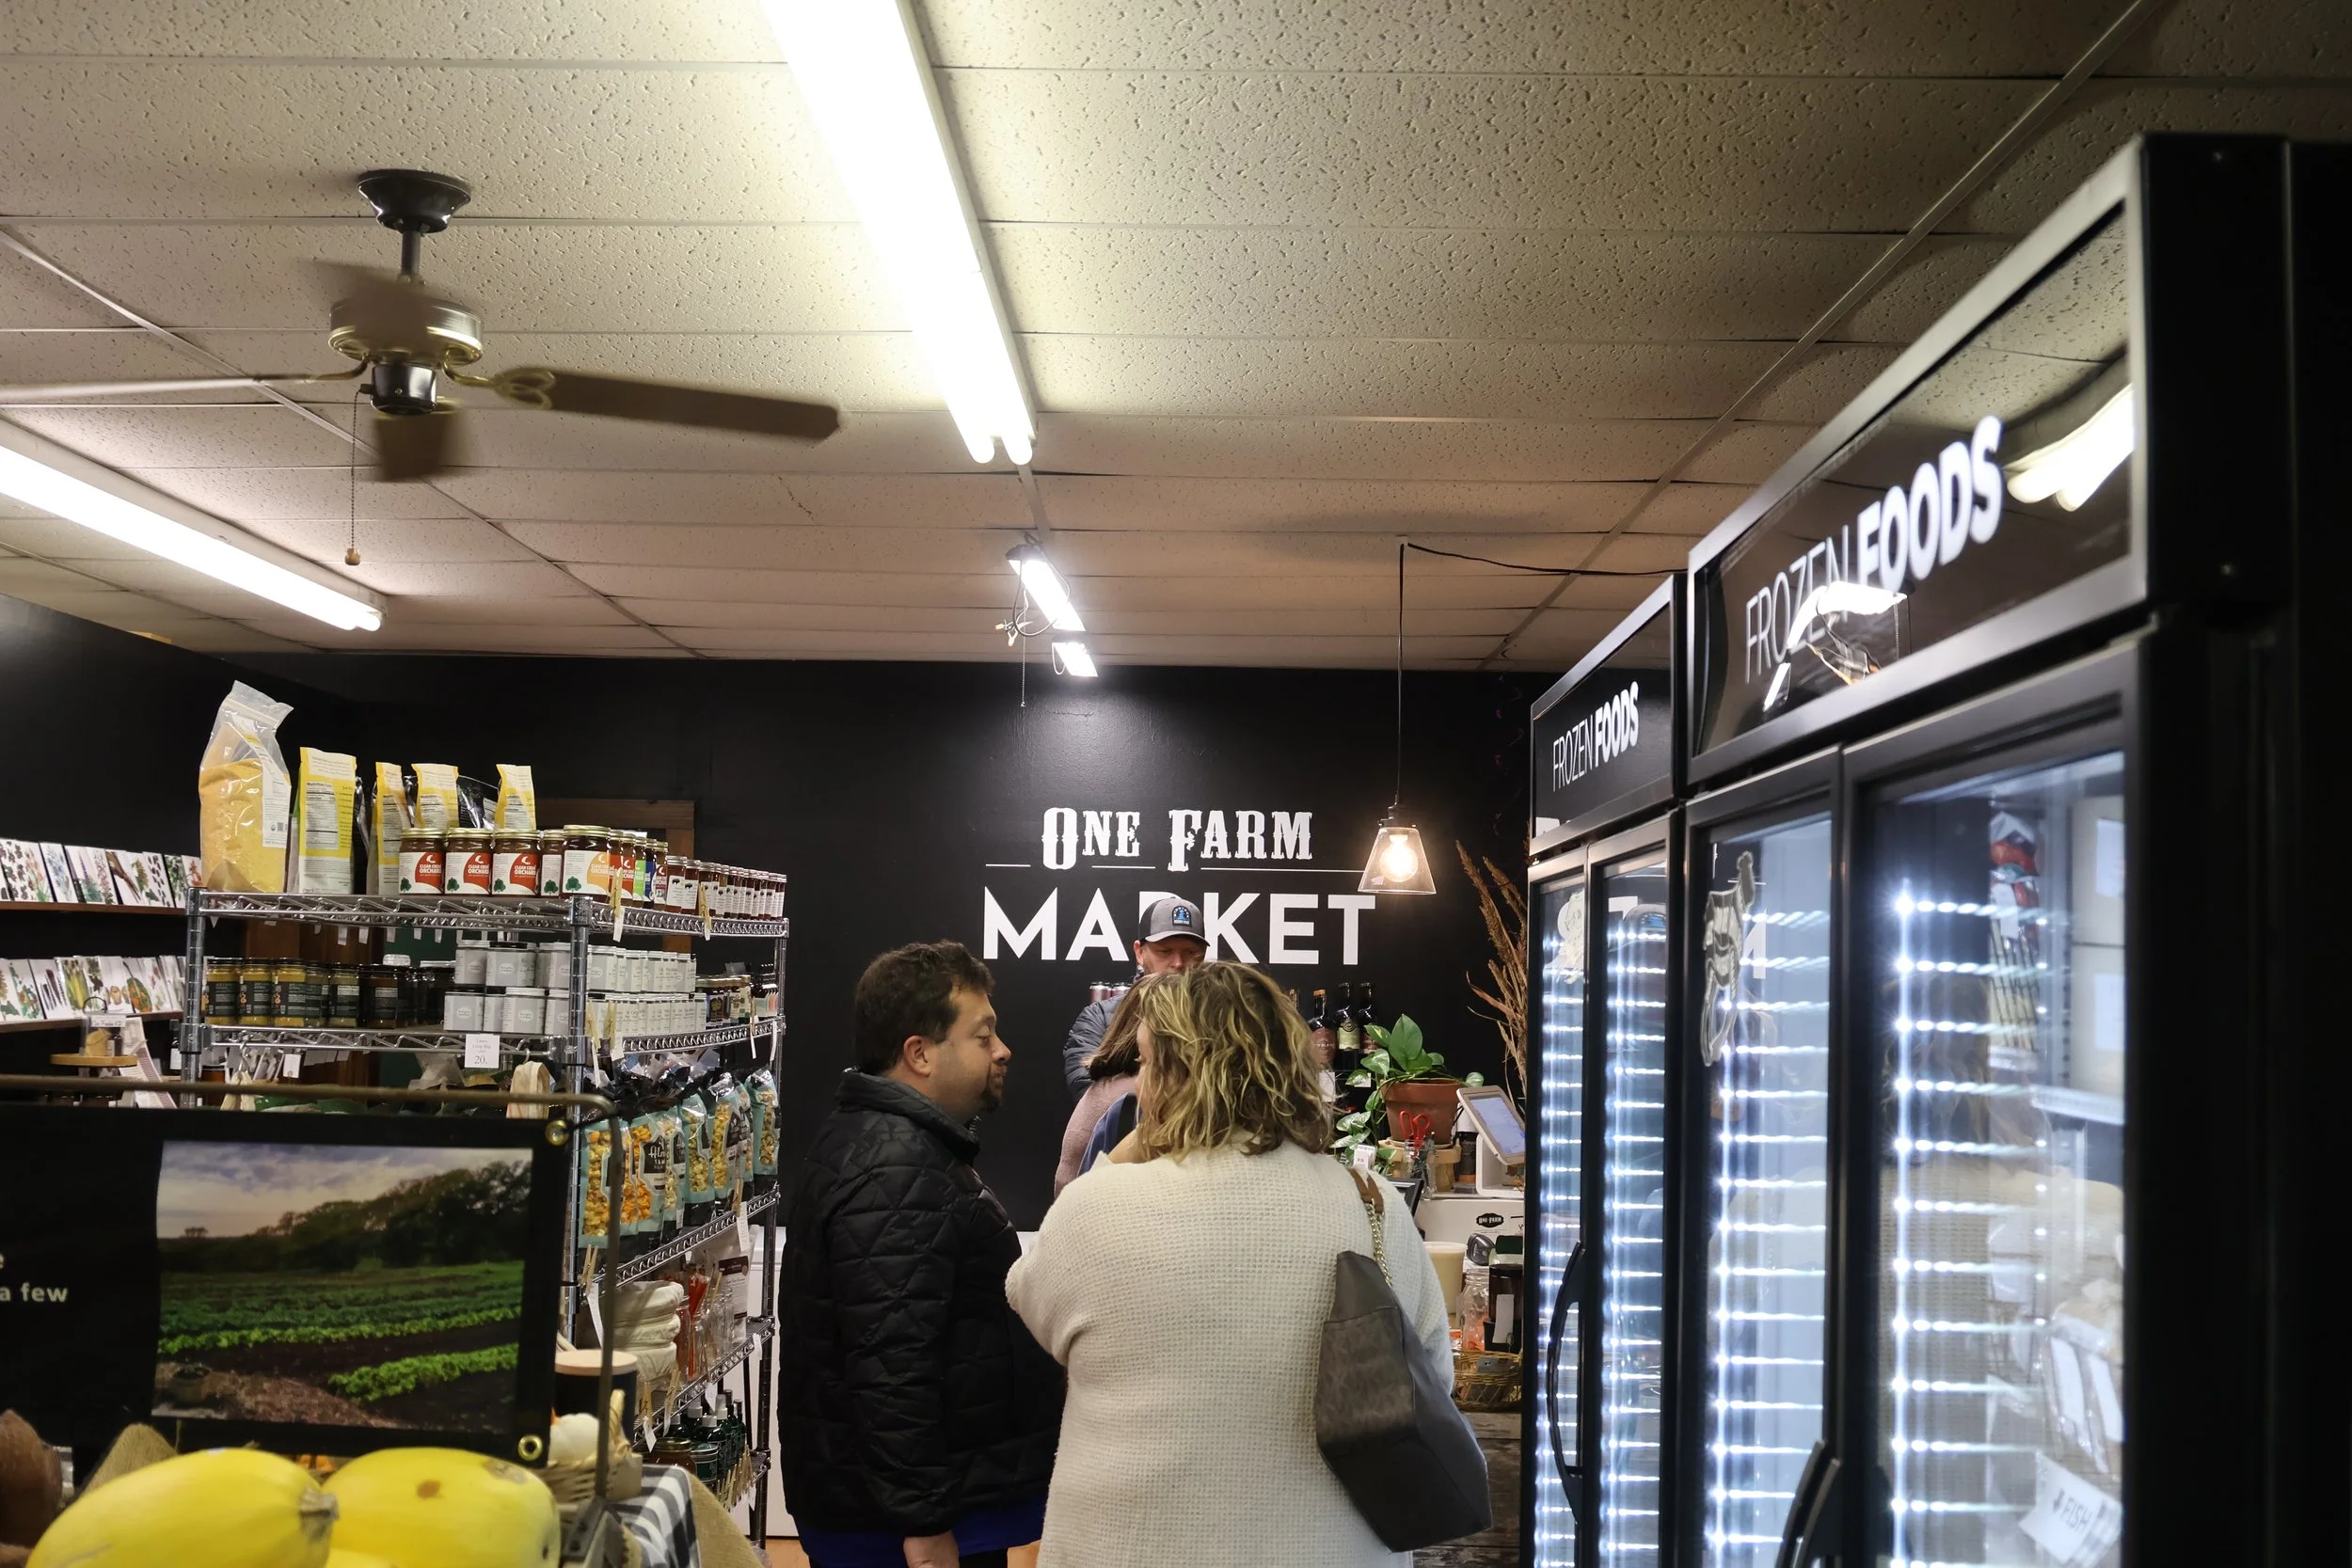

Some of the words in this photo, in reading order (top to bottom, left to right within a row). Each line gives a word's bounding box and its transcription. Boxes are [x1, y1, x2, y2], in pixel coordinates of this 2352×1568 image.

[1745, 524, 1849, 685] FROZEN
[1857, 415, 2003, 596] FOODS
[1553, 714, 1594, 792] FROZEN
[1596, 681, 1639, 768] FOODS
[1041, 807, 1141, 870] ONE
[1168, 809, 1314, 872] FARM
[982, 886, 1376, 965] MAKET
[21, 1281, 69, 1303] few
[2059, 1497, 2093, 1535] FISH
